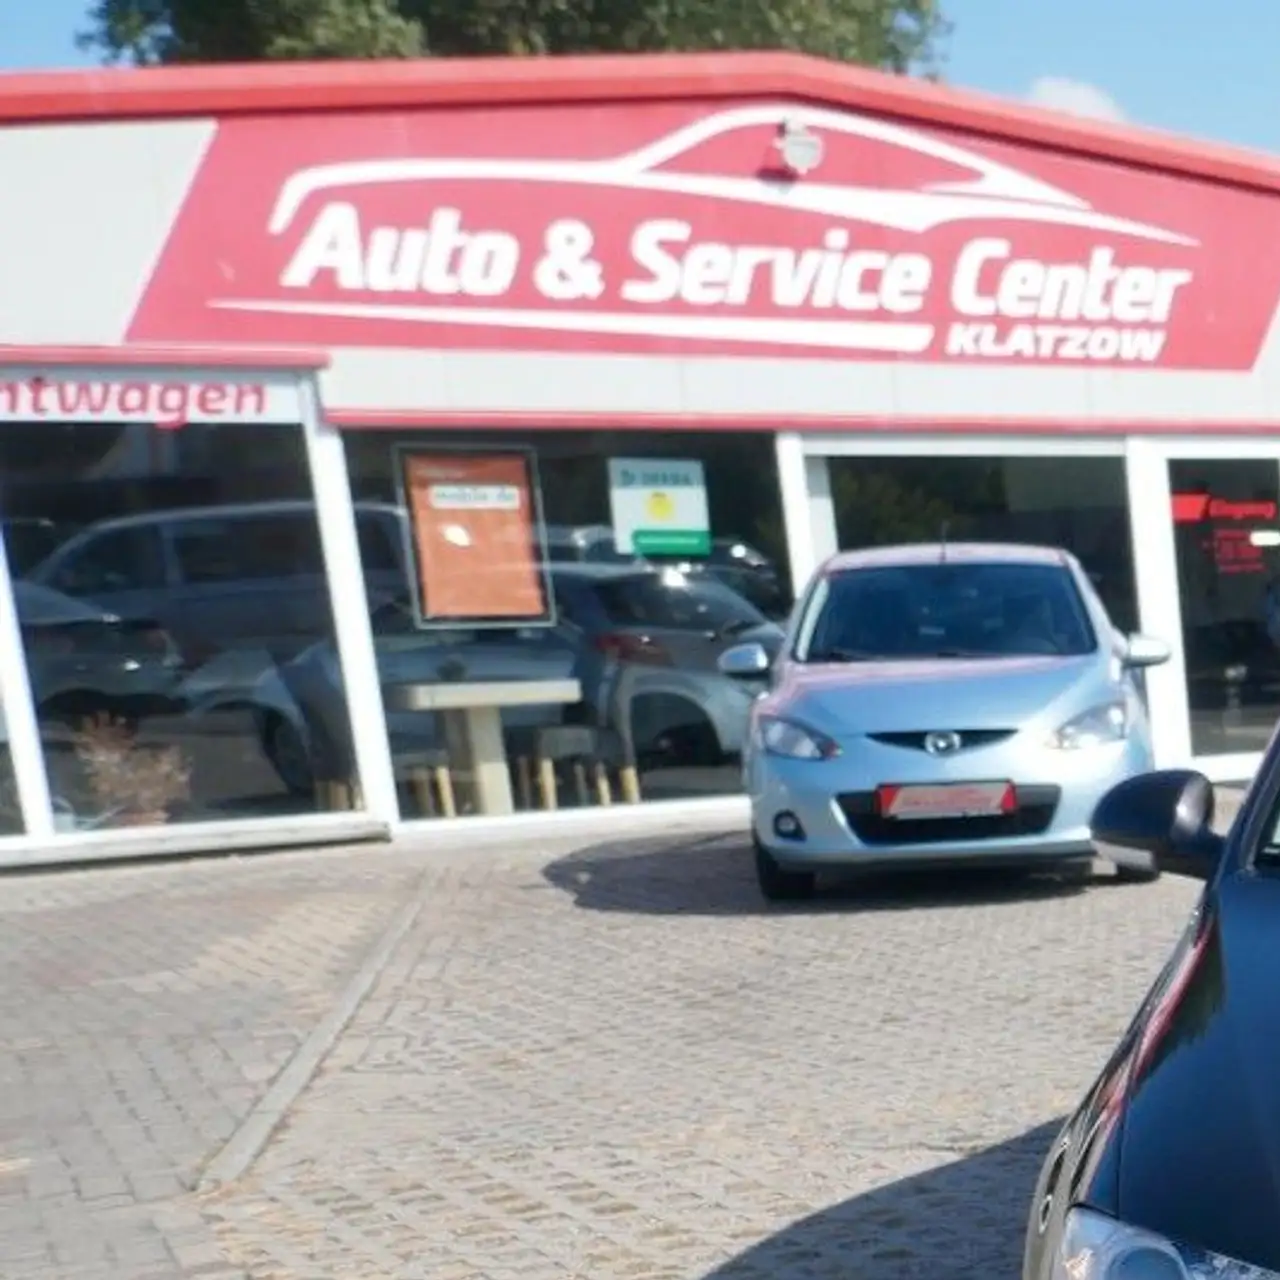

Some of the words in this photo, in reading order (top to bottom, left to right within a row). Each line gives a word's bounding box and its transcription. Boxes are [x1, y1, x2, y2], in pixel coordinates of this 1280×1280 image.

[280, 202, 519, 294] Auto
[533, 219, 604, 300] &
[621, 219, 932, 311] Service
[951, 238, 1192, 324] Center
[946, 323, 1166, 362] KLATZOW
